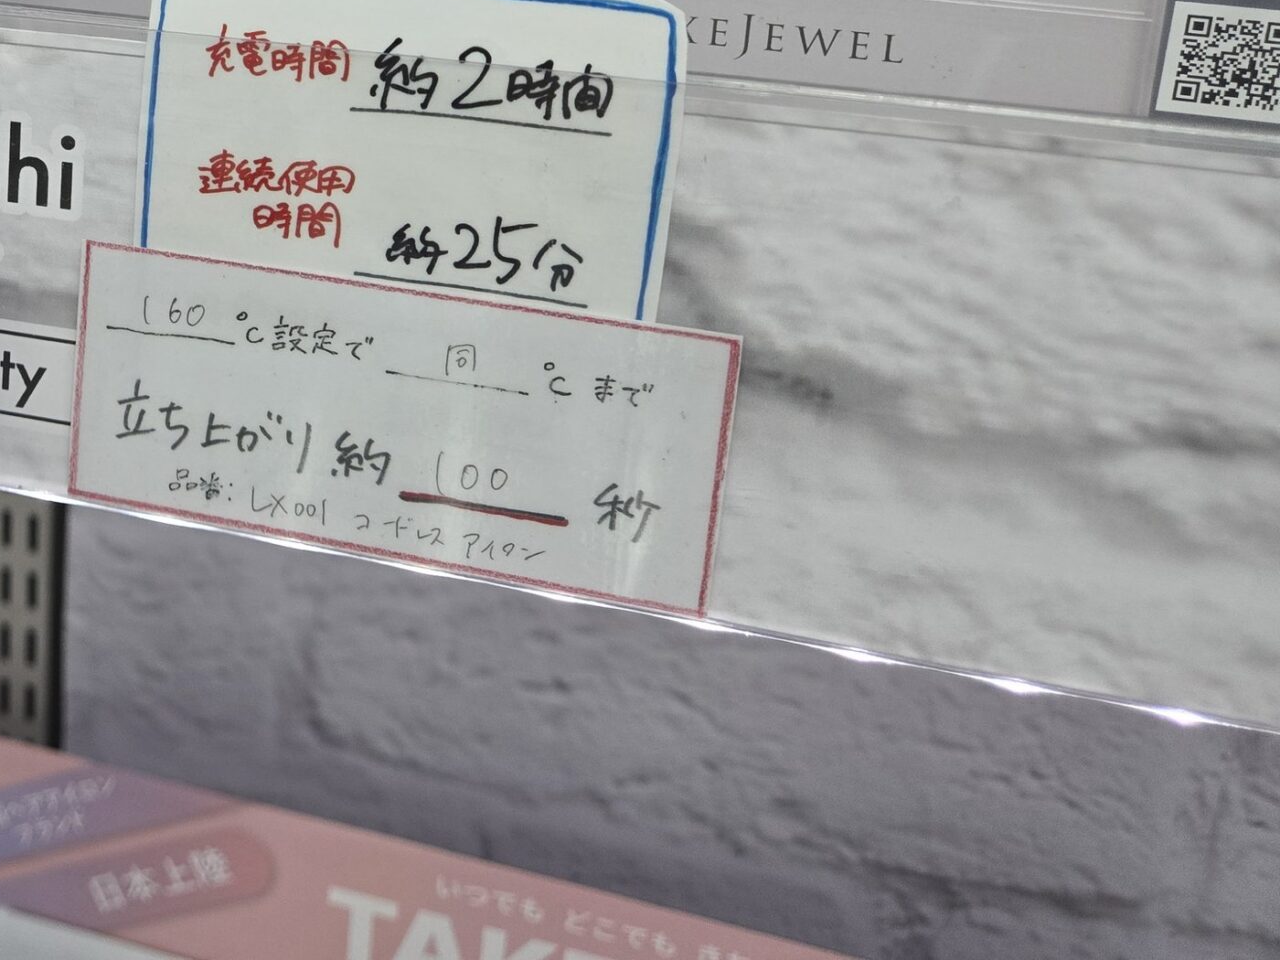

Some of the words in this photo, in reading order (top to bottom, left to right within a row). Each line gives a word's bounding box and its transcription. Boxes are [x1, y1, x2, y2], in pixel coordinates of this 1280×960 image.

[205, 23, 351, 82] 充電時間
[685, 12, 904, 64] XEJEWEL
[198, 150, 356, 197] 連続使用
[253, 201, 342, 248] 時間
